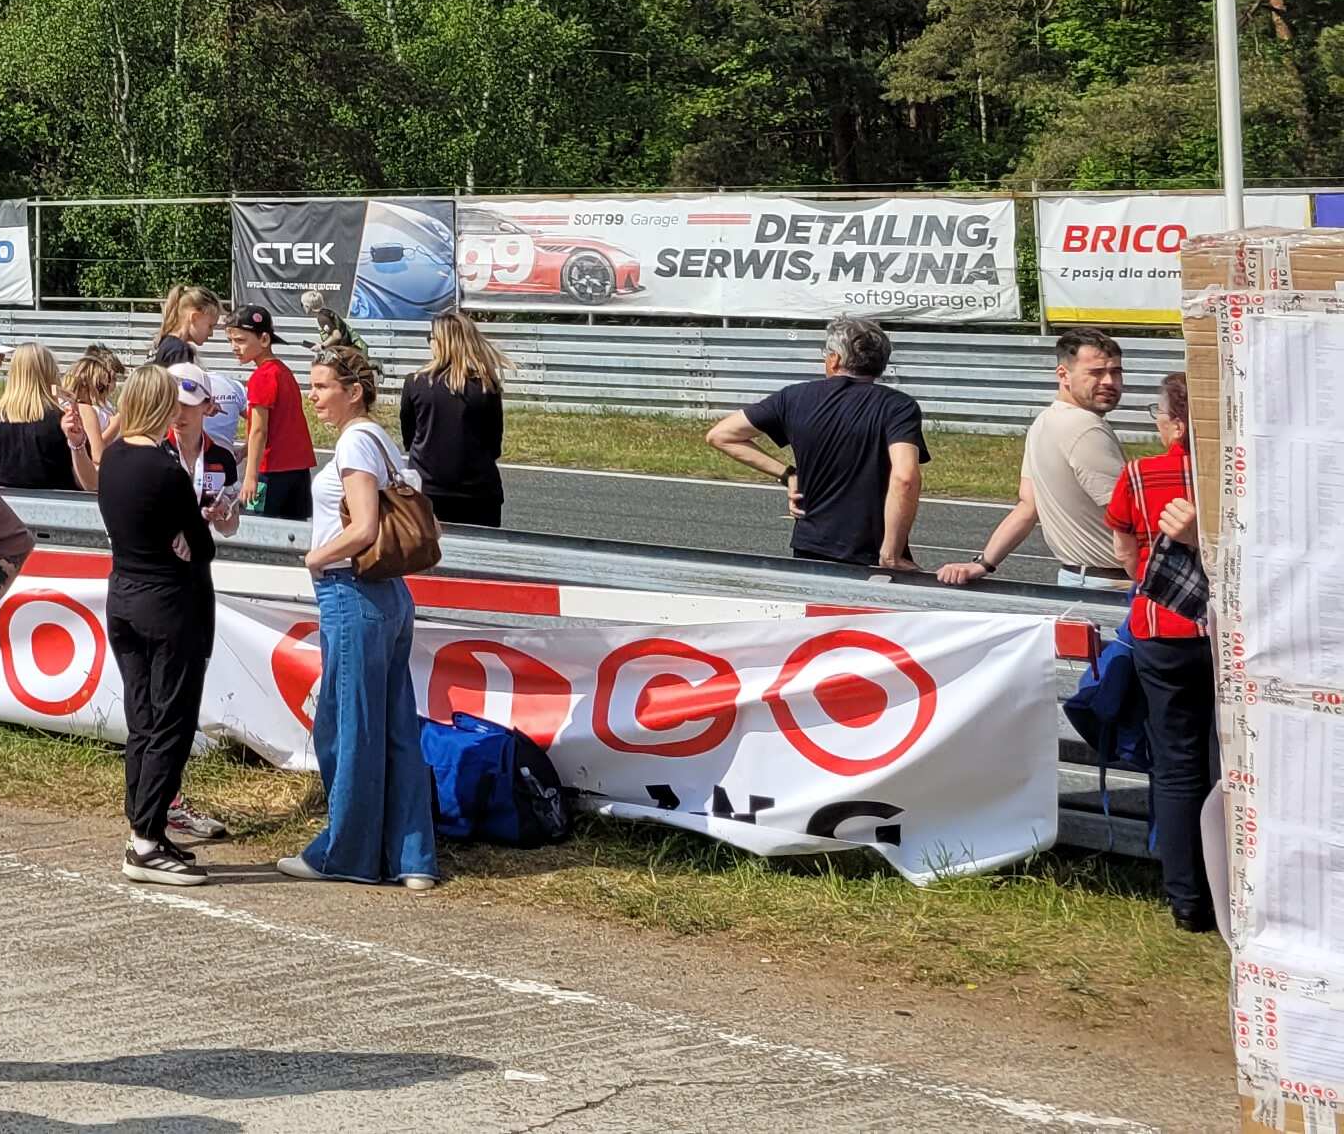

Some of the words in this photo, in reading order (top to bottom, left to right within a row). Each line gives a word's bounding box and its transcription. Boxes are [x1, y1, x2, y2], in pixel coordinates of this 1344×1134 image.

[573, 213, 624, 227] SOFT99
[630, 213, 679, 227] Garage
[754, 214, 998, 249] DETAILING,
[1062, 224, 1188, 253] BRICO
[253, 243, 335, 266] CTEK
[654, 248, 820, 285] SERWIS,
[827, 252, 1001, 285] MYJNIA
[1072, 267, 1114, 281] pasją
[1118, 268, 1143, 278] dla
[1147, 268, 1181, 278] dom
[843, 289, 1002, 310] soft99garage.pl
[1224, 446, 1233, 495] RACING
